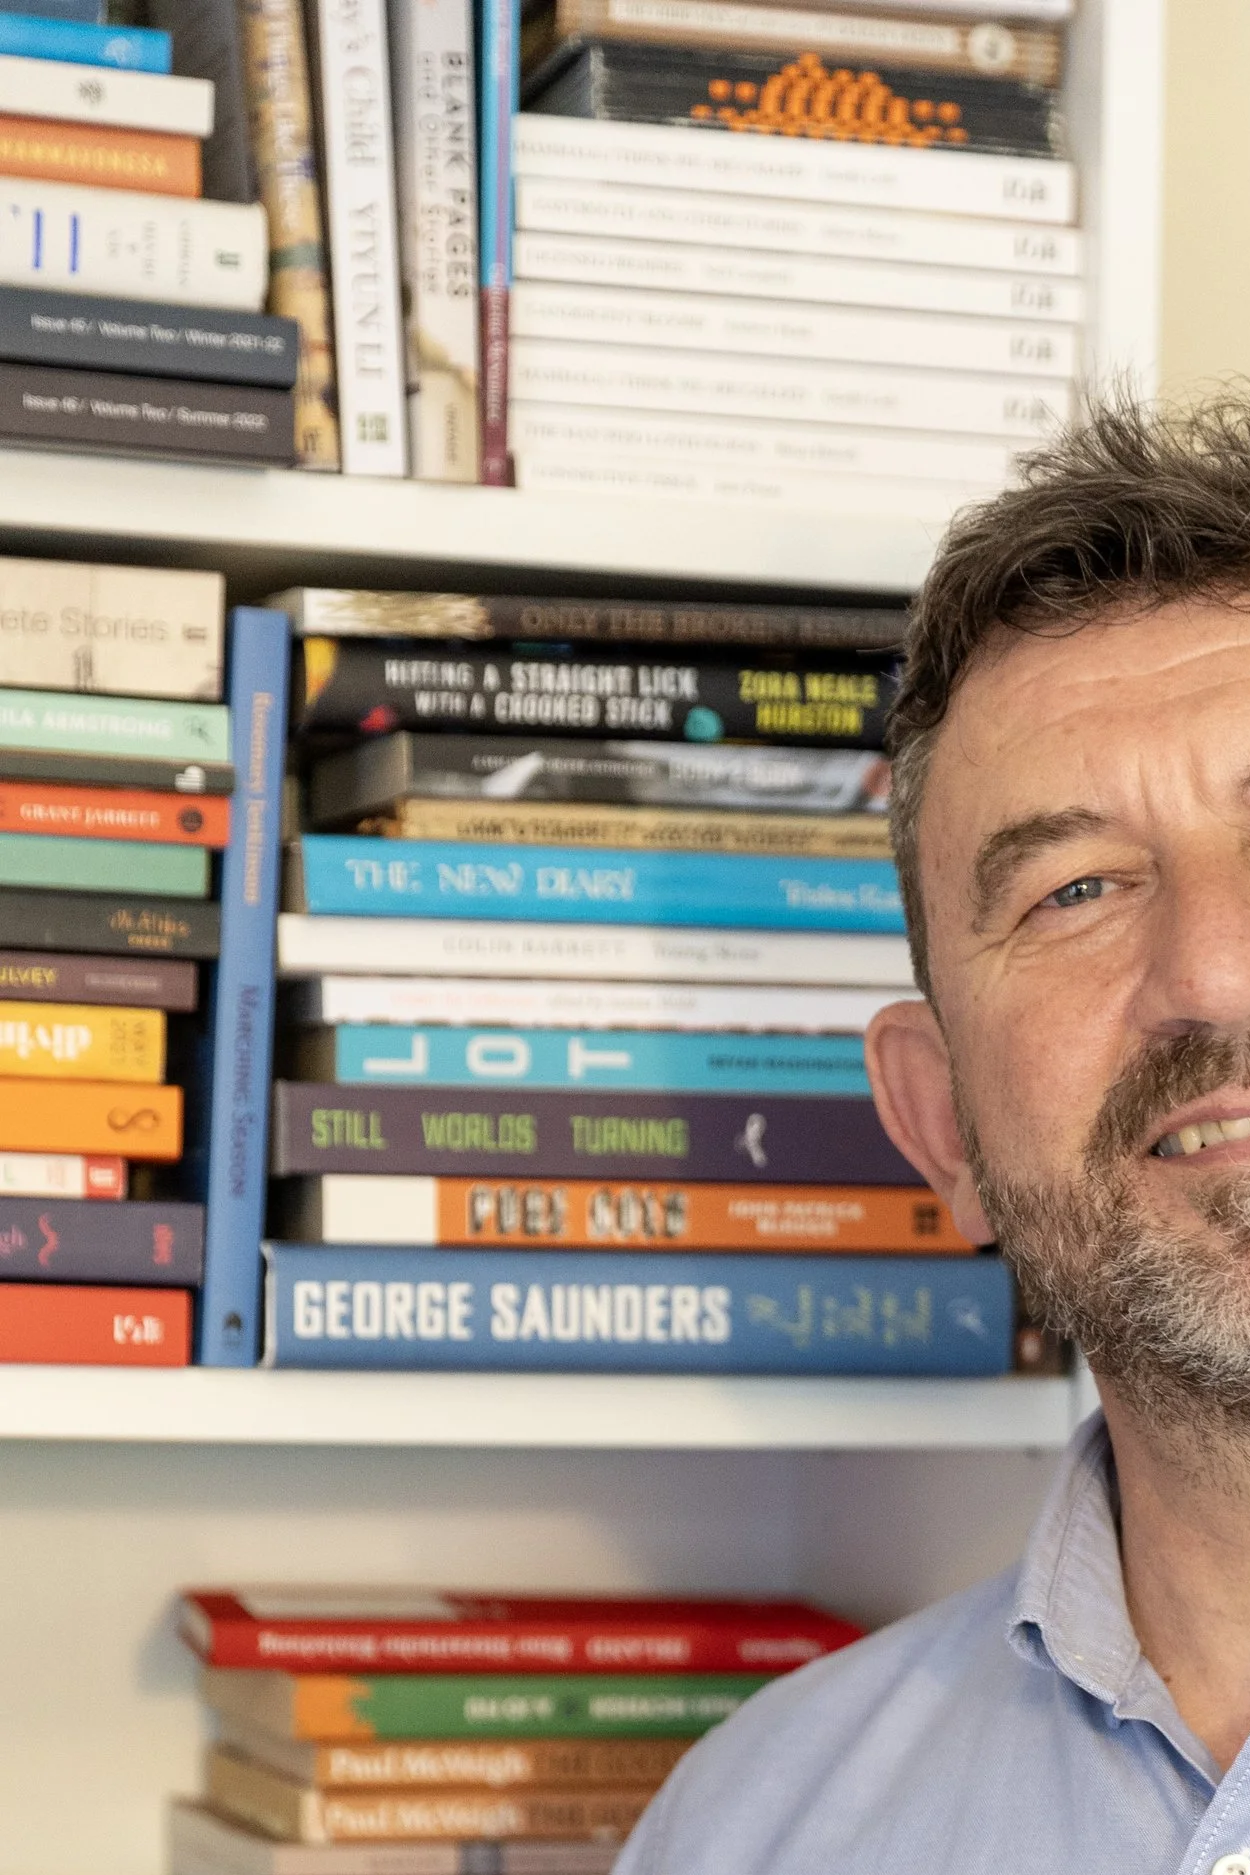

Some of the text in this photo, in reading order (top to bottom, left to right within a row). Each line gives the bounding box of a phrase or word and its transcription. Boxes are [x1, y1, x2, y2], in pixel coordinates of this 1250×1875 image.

[441, 49, 476, 300] BLANK PAGES
[58, 608, 169, 643] Stories
[521, 603, 598, 638] ONLY
[609, 605, 664, 639] THE
[509, 660, 635, 698] STRAIGHT
[638, 665, 700, 700] LICK
[737, 668, 799, 702] ZORA
[414, 690, 464, 718] WITH
[493, 692, 599, 729] CROOKED
[604, 697, 674, 730] STICK
[344, 858, 638, 901] THE NEW DIARY
[311, 1108, 690, 1159] STILL WORLDS TURNING
[291, 1279, 474, 1342] GEORGE
[489, 1281, 731, 1345] SAUNDERS
